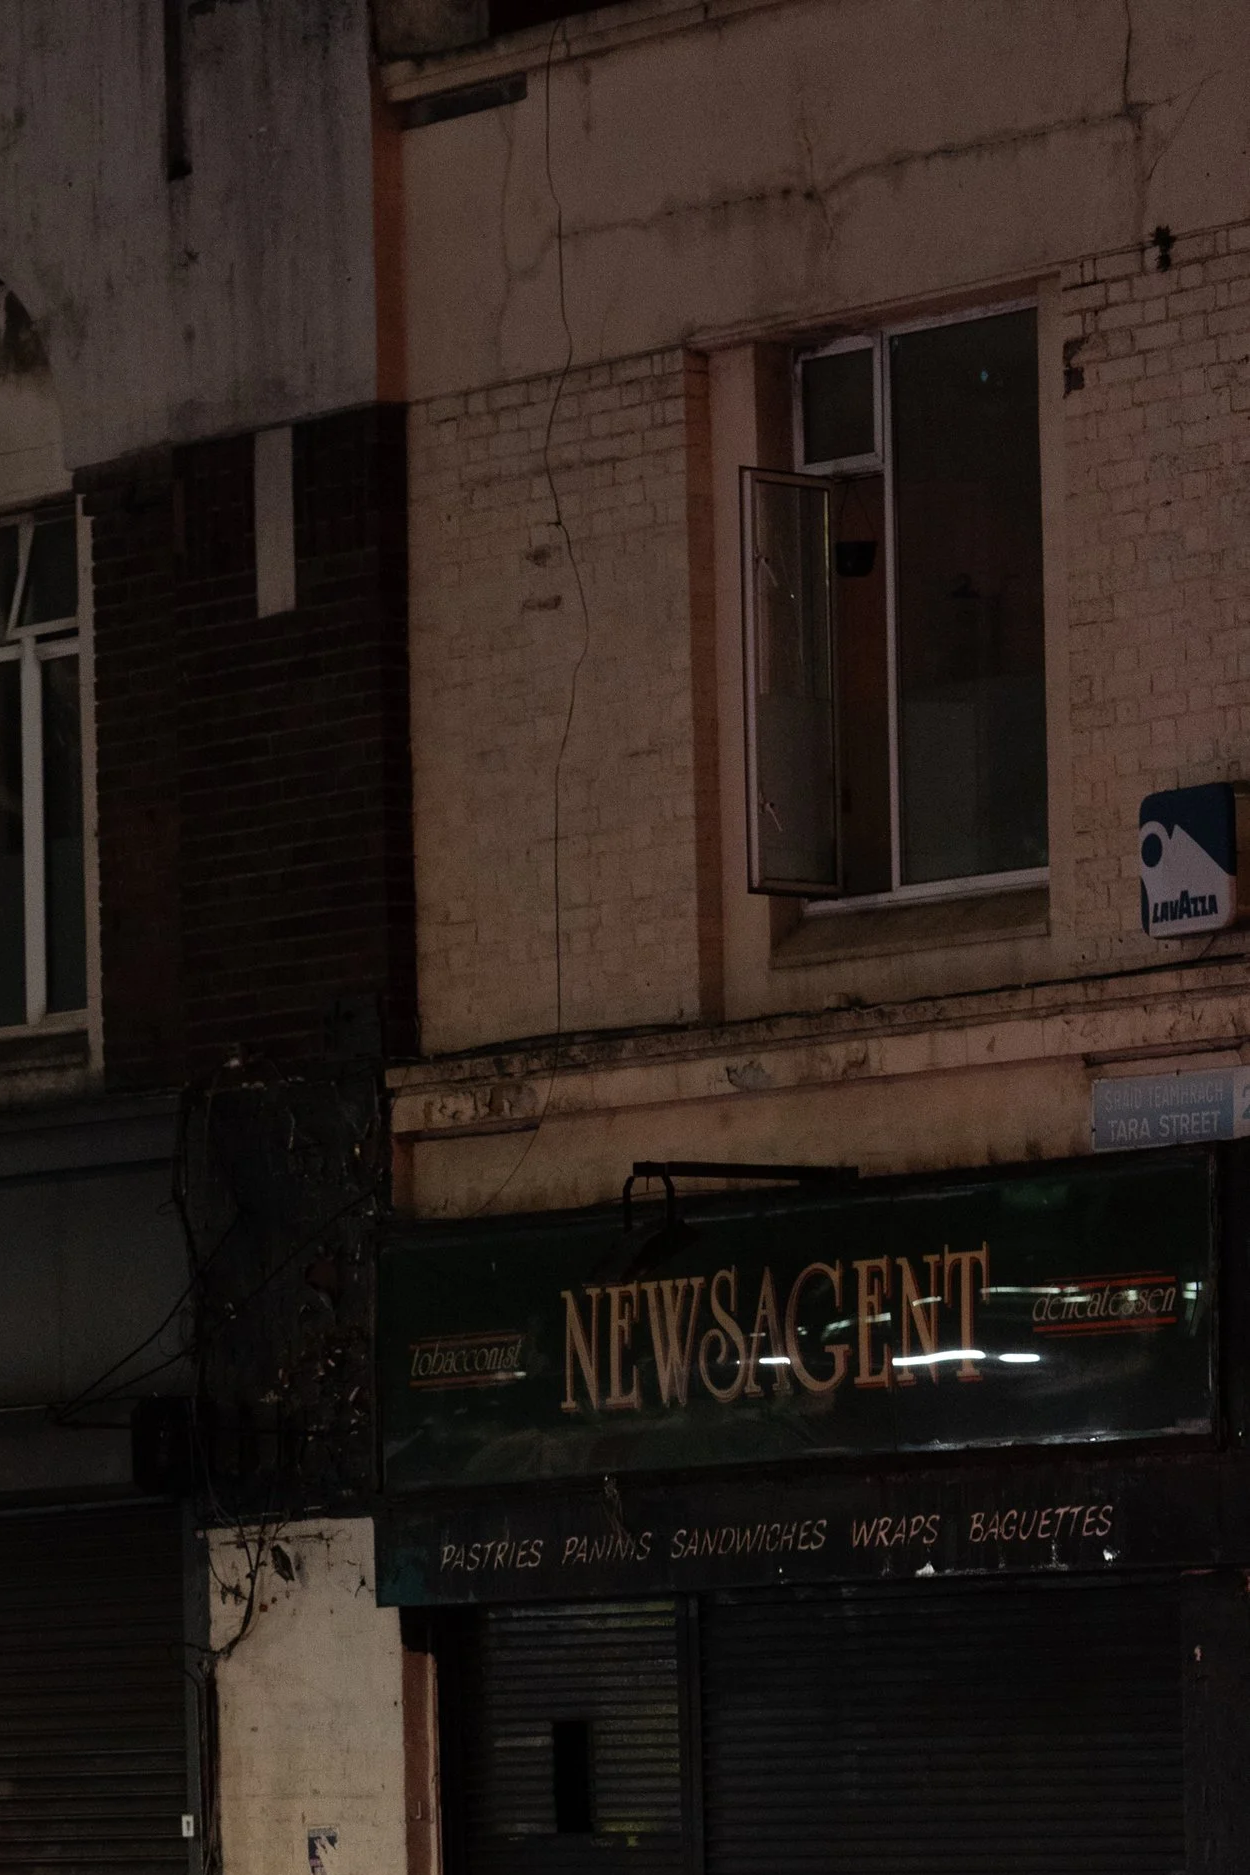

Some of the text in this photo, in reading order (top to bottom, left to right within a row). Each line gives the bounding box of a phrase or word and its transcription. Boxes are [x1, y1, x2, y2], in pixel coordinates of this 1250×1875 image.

[1152, 889, 1219, 923] LAVAZZA
[1107, 1110, 1221, 1142] TARA STREET
[560, 1240, 991, 1415] NEWSAGENT
[410, 1338, 523, 1377] tobacconist
[440, 1503, 1114, 1572] PASTRIES PANINIS SANDWICHES WRAPS BAGUETTES
